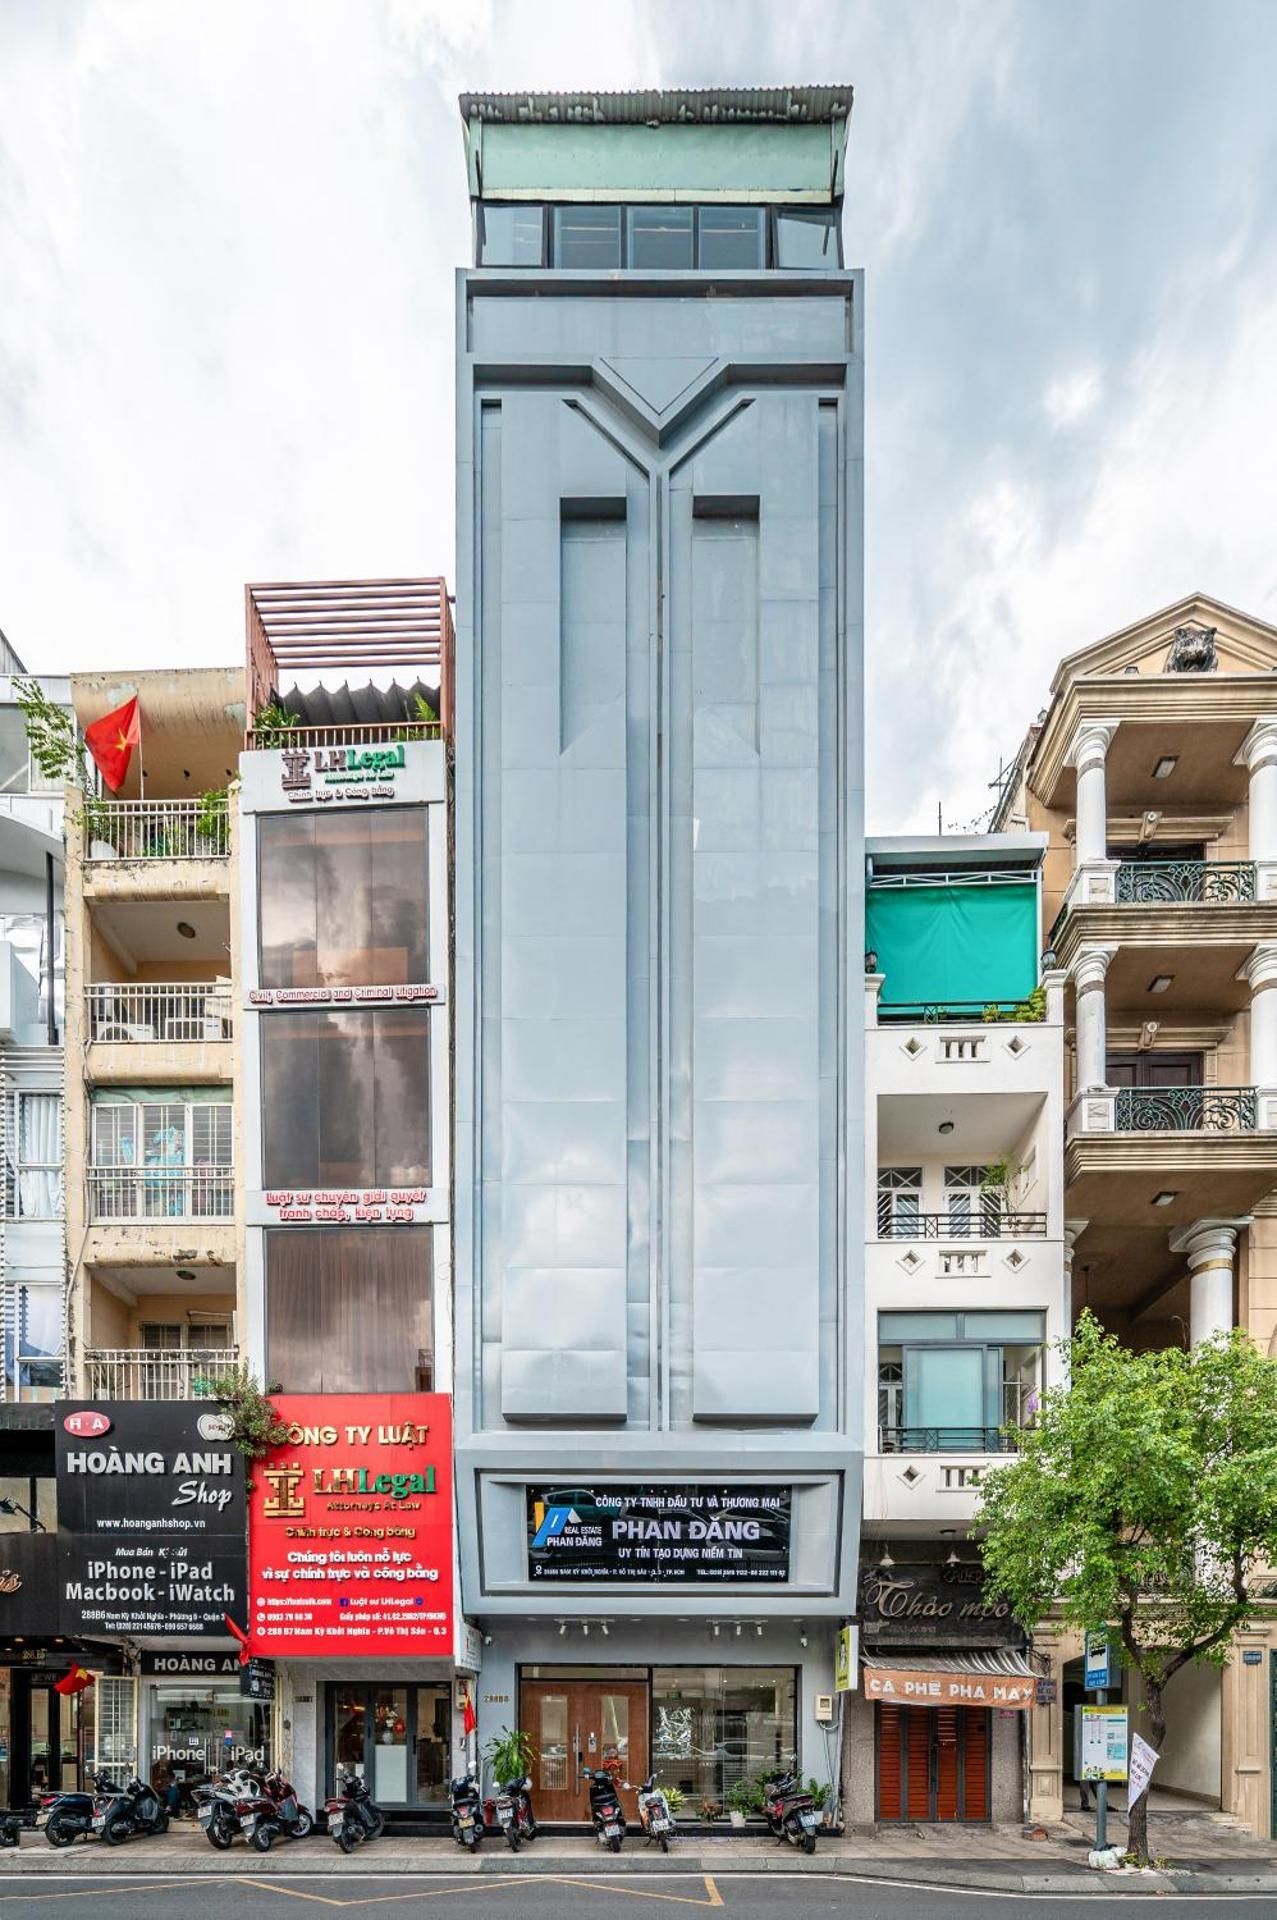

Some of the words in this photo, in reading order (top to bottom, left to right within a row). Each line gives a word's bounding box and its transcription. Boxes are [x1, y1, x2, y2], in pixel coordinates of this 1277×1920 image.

[314, 745, 405, 771] LHLegal
[275, 989, 331, 1003] Commercial
[333, 989, 352, 1001] and
[354, 987, 393, 1000] Criminal
[396, 985, 438, 1001] Litigation
[314, 1191, 358, 1208] chuyên
[345, 1425, 371, 1444] TY
[378, 1422, 428, 1449] LUẬT
[67, 1446, 165, 1474] HOÀNG
[172, 1453, 232, 1474] ANH
[312, 1465, 437, 1499] LHLegal
[171, 1480, 233, 1512] Shop
[595, 1495, 621, 1508] CÔNG
[624, 1497, 637, 1508] TY
[641, 1497, 665, 1508] TNHH
[690, 1496, 704, 1508] TƯ
[706, 1494, 719, 1508] VÀ
[721, 1496, 759, 1509] THƯƠNG
[761, 1497, 780, 1510] MẠI
[97, 1517, 206, 1531] www.hoanganhshop.vn
[344, 1527, 352, 1537] &
[564, 1526, 579, 1534] REAL
[581, 1526, 602, 1535] ESTATE
[612, 1520, 681, 1539] PHAN
[688, 1516, 760, 1540] ĐĂNG
[547, 1537, 573, 1547] PHAN
[575, 1535, 602, 1547] ĐĂNG
[115, 1547, 135, 1557] Mua
[137, 1546, 154, 1557] Bán
[287, 1550, 328, 1564] Chúng
[329, 1550, 345, 1562] tôi
[347, 1550, 372, 1562] luôn
[374, 1547, 390, 1562] nỗ
[393, 1551, 412, 1564] lực
[618, 1548, 632, 1558] UY
[634, 1545, 650, 1558] TÍN
[653, 1548, 671, 1560] TẠO
[673, 1547, 699, 1561] DỰNG
[728, 1548, 743, 1558] TIN
[87, 1561, 156, 1580] iPhone
[170, 1561, 213, 1580] iPad
[262, 1566, 274, 1579] vì
[275, 1568, 290, 1582] sự
[293, 1566, 325, 1579] chính
[327, 1568, 351, 1582] trực
[354, 1565, 370, 1578] và
[373, 1566, 405, 1581] công
[406, 1563, 439, 1581] bằng
[65, 1583, 156, 1601] Macbook
[169, 1583, 236, 1601] iWatch
[81, 1609, 106, 1620] 288B6
[154, 1654, 216, 1672] HOÀNG
[949, 1683, 985, 1699] PHA
[152, 1745, 206, 1761] iPhone
[231, 1745, 265, 1761] iPad
